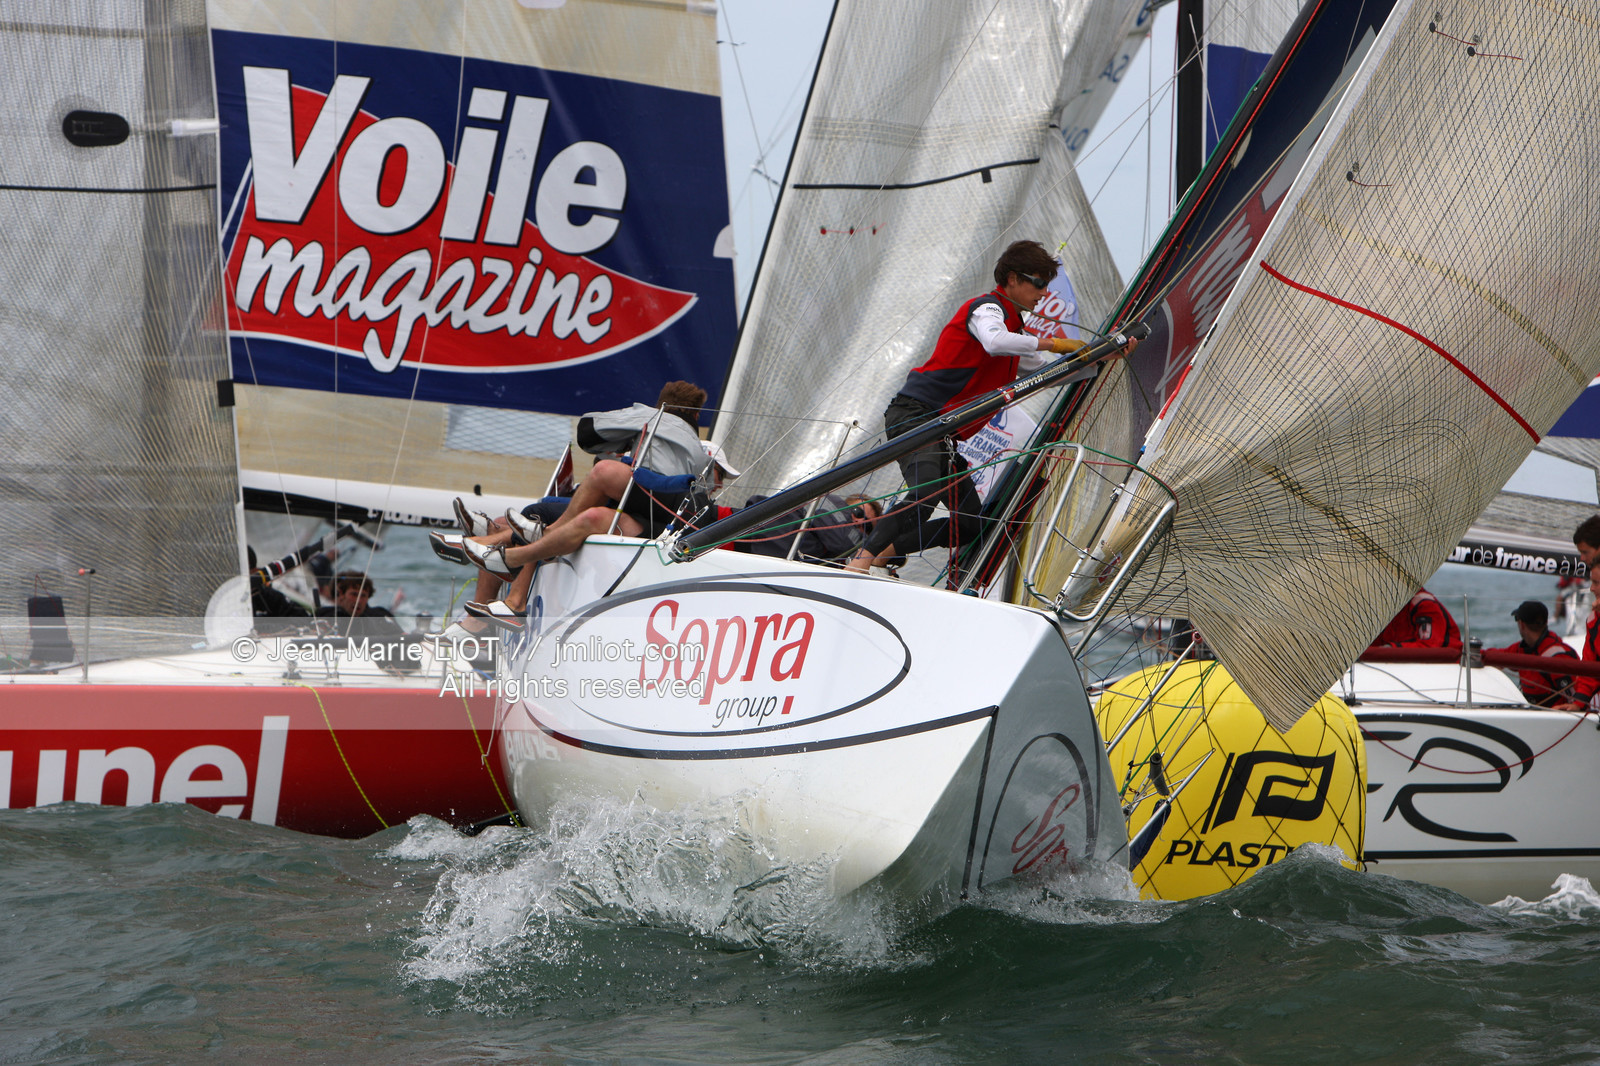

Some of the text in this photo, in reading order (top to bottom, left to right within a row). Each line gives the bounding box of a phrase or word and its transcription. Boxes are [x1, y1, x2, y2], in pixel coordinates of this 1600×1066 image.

[243, 66, 627, 255] Voile
[235, 235, 613, 373] magazine
[1472, 545, 1494, 565] de
[1495, 547, 1558, 574] france
[1559, 555, 1571, 575] à
[1574, 557, 1587, 577] la
[640, 599, 815, 705] Sopra
[712, 694, 779, 729] group
